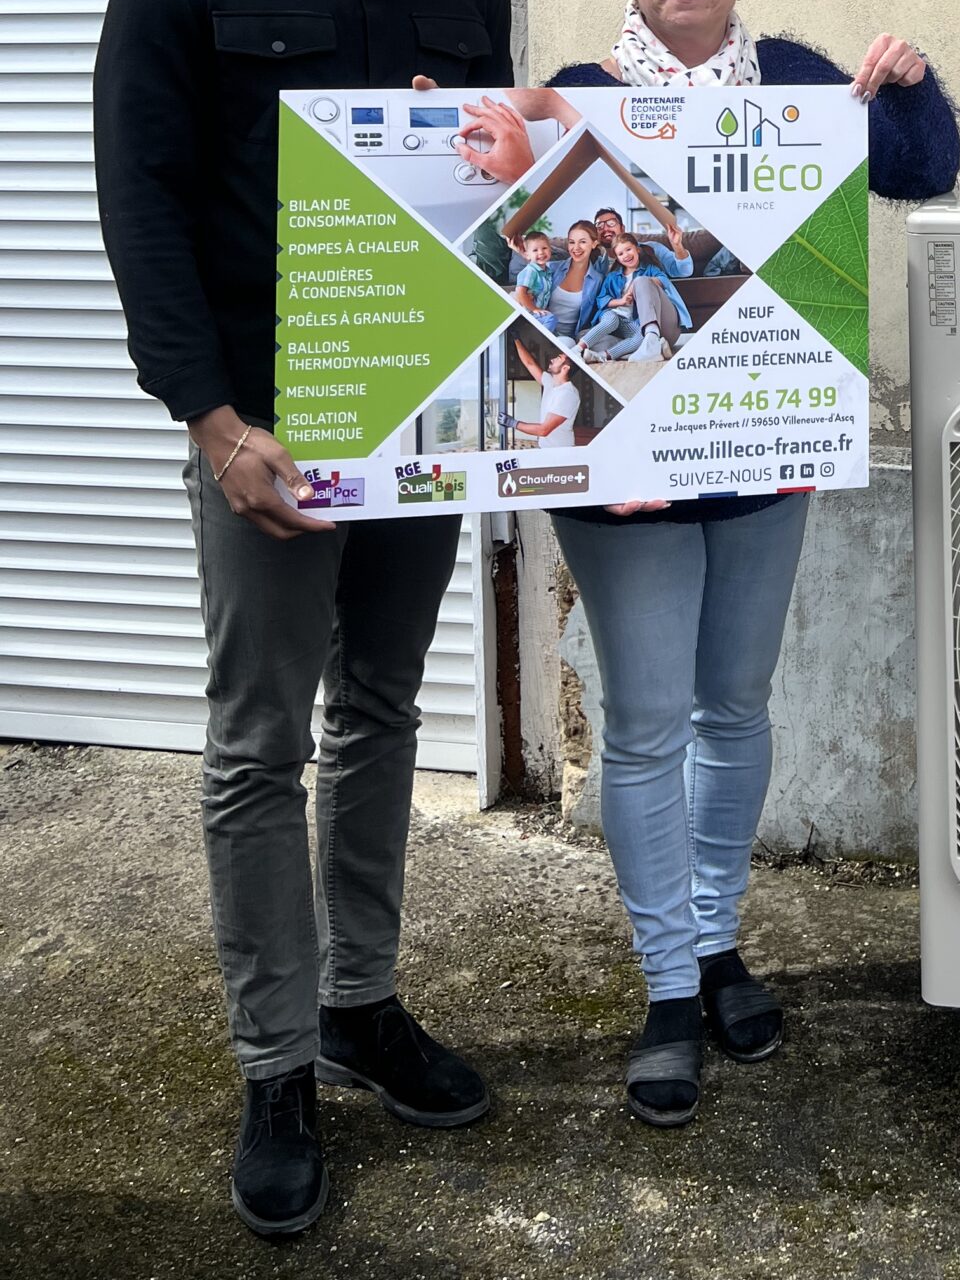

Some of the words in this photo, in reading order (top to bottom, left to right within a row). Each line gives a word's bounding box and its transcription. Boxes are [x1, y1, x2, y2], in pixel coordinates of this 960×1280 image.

[631, 104, 682, 113] ÉCONOMIES
[687, 153, 823, 193] Lilléco
[289, 199, 330, 212] BILAN
[334, 199, 351, 211] DE
[737, 201, 775, 210] FRANCE
[289, 214, 396, 228] CONSOMMATION
[288, 242, 342, 256] POMPES
[345, 239, 355, 254] À
[358, 240, 420, 254] CHALEUR
[289, 267, 373, 283] CHAUDIÈRES
[288, 285, 299, 300] À
[302, 284, 406, 299] CONDENSATION
[287, 311, 337, 327] POÊLES
[340, 310, 350, 326] À
[353, 308, 425, 325] GRANULÉS
[738, 306, 775, 319] NEUF
[711, 328, 800, 344] RÉNOVATION
[288, 340, 350, 355] BALLONS
[287, 354, 430, 371] THERMODYNAMIQUES
[677, 354, 749, 370] GARANTIE
[752, 350, 833, 366] DÉCENNALE
[286, 383, 367, 398] MENUISERIE
[672, 393, 700, 415] 03
[706, 392, 734, 413] 74
[739, 390, 769, 411] 46
[775, 388, 802, 410] 74
[808, 386, 837, 408] 99
[287, 411, 357, 426] ISOLATION
[650, 424, 656, 433] 2
[658, 425, 672, 433] rue
[674, 421, 707, 434] Jacques
[709, 419, 739, 430] Prévert
[751, 417, 780, 427] 59650
[782, 413, 855, 426] Villeneuve-d'Ascq
[286, 427, 363, 443] THERMIQUE
[652, 433, 853, 463] www.lilleco-france.fr
[395, 461, 422, 480] RGE
[495, 458, 518, 473] RGE
[303, 468, 321, 483] GE
[669, 467, 772, 487] SUIVEZ-NOUS
[312, 487, 332, 499] uali
